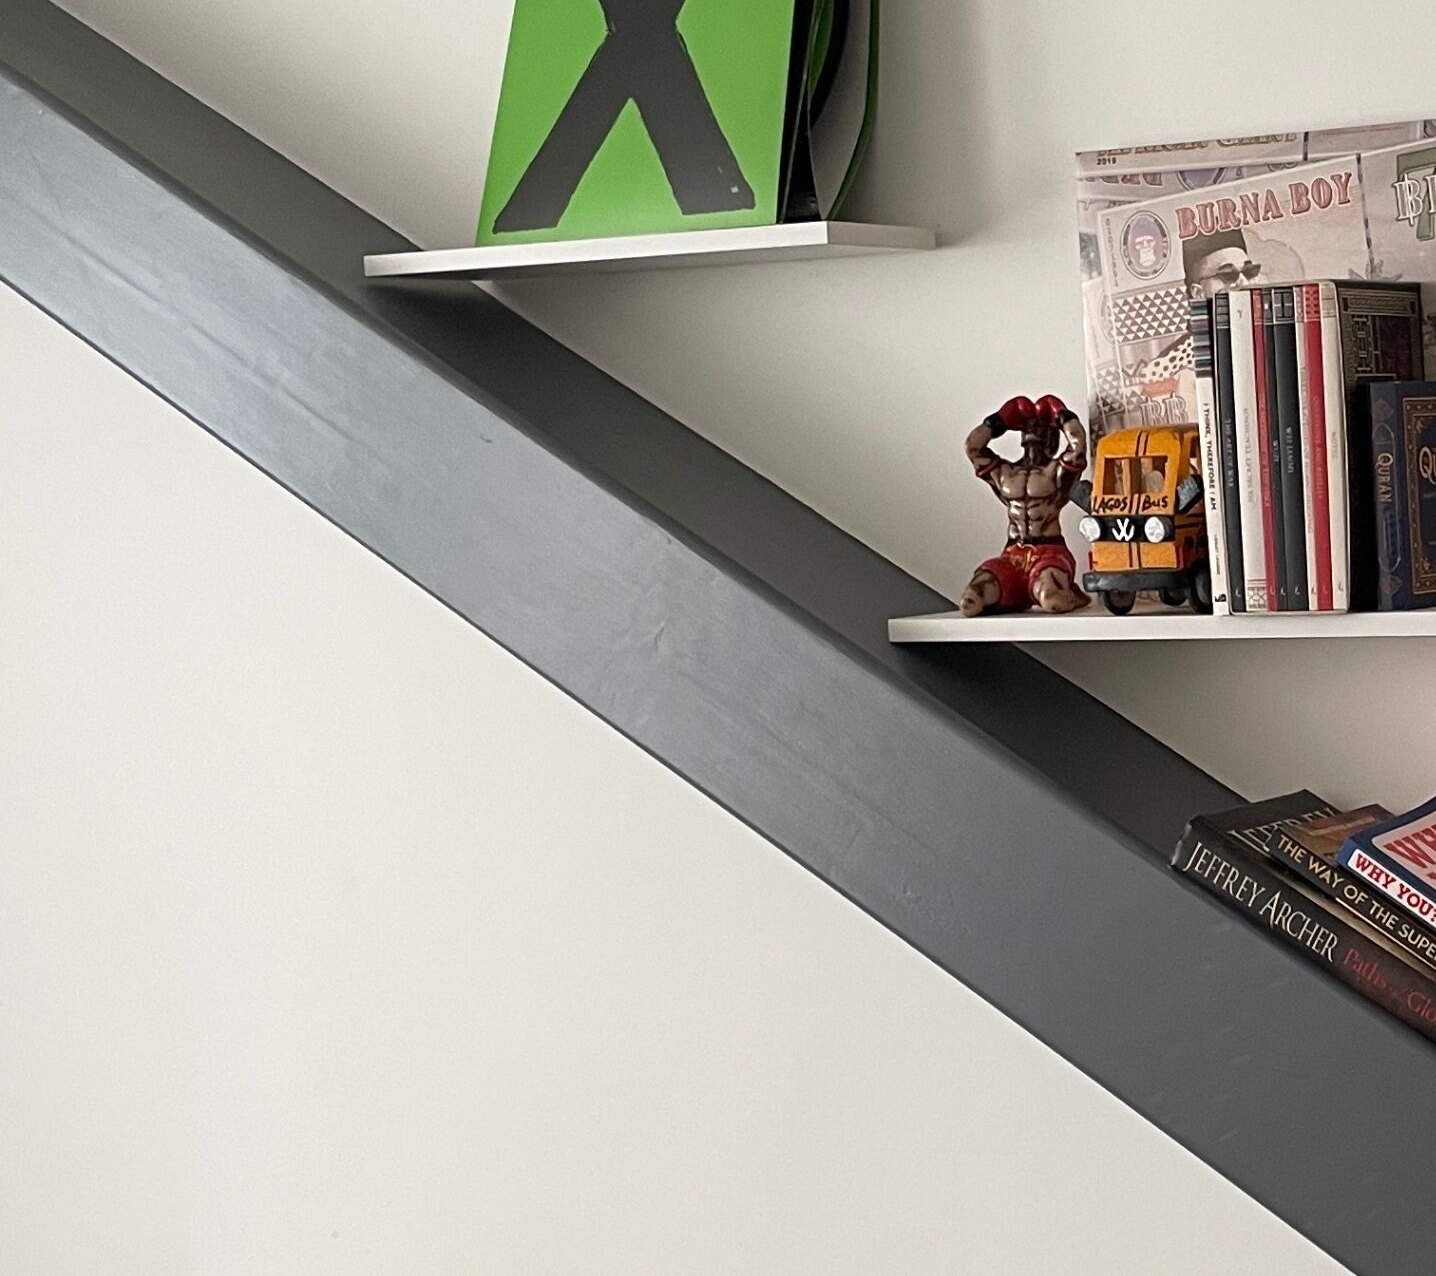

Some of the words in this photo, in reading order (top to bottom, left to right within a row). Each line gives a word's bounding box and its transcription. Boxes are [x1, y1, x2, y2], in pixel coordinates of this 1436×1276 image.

[1175, 189, 1284, 240] BURNA
[1289, 172, 1352, 215] BOY
[1207, 440, 1215, 490] THEREFORE
[1093, 495, 1128, 513] LAGOS
[1210, 496, 1216, 510] AM
[1277, 834, 1307, 863] THE
[1308, 855, 1345, 889] WAY
[1343, 884, 1369, 904] OF
[1369, 899, 1400, 931] THE
[1355, 852, 1398, 890] WHY
[1182, 841, 1266, 908] JEFFREY
[1259, 891, 1338, 963] ARCHER
[1343, 948, 1388, 989] Paths
